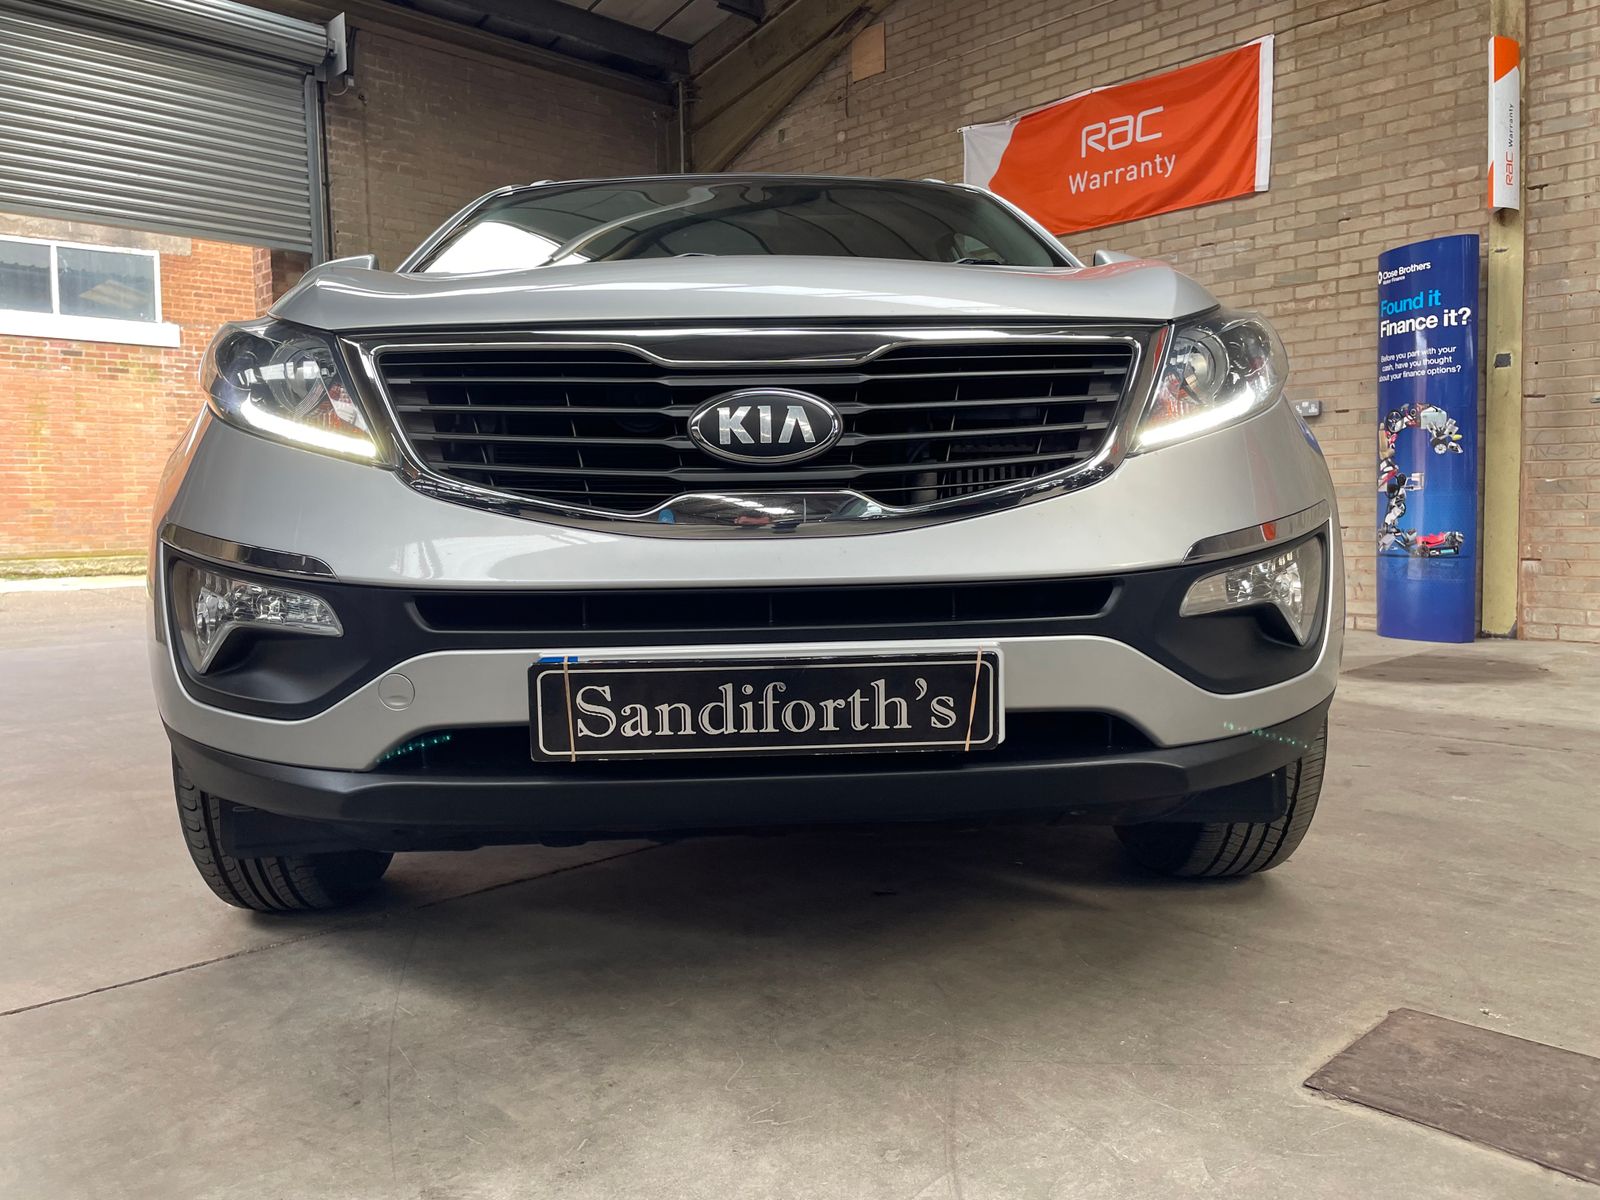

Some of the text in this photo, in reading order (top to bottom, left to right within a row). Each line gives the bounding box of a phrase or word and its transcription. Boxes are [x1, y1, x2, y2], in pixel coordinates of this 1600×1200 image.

[1068, 154, 1176, 195] Warranty
[1398, 262, 1431, 275] Brothers
[1380, 289, 1441, 317] Found it
[1380, 307, 1471, 337] Finance it?
[1395, 362, 1408, 370] have
[1409, 360, 1421, 369] you
[1422, 356, 1452, 365] thought
[1396, 353, 1406, 361] you
[1407, 350, 1420, 359] part
[1421, 347, 1436, 355] with
[1438, 346, 1456, 356] your
[1390, 372, 1402, 381] your
[1403, 369, 1426, 378] finance
[1427, 365, 1461, 376] options?
[717, 405, 816, 445] KIA
